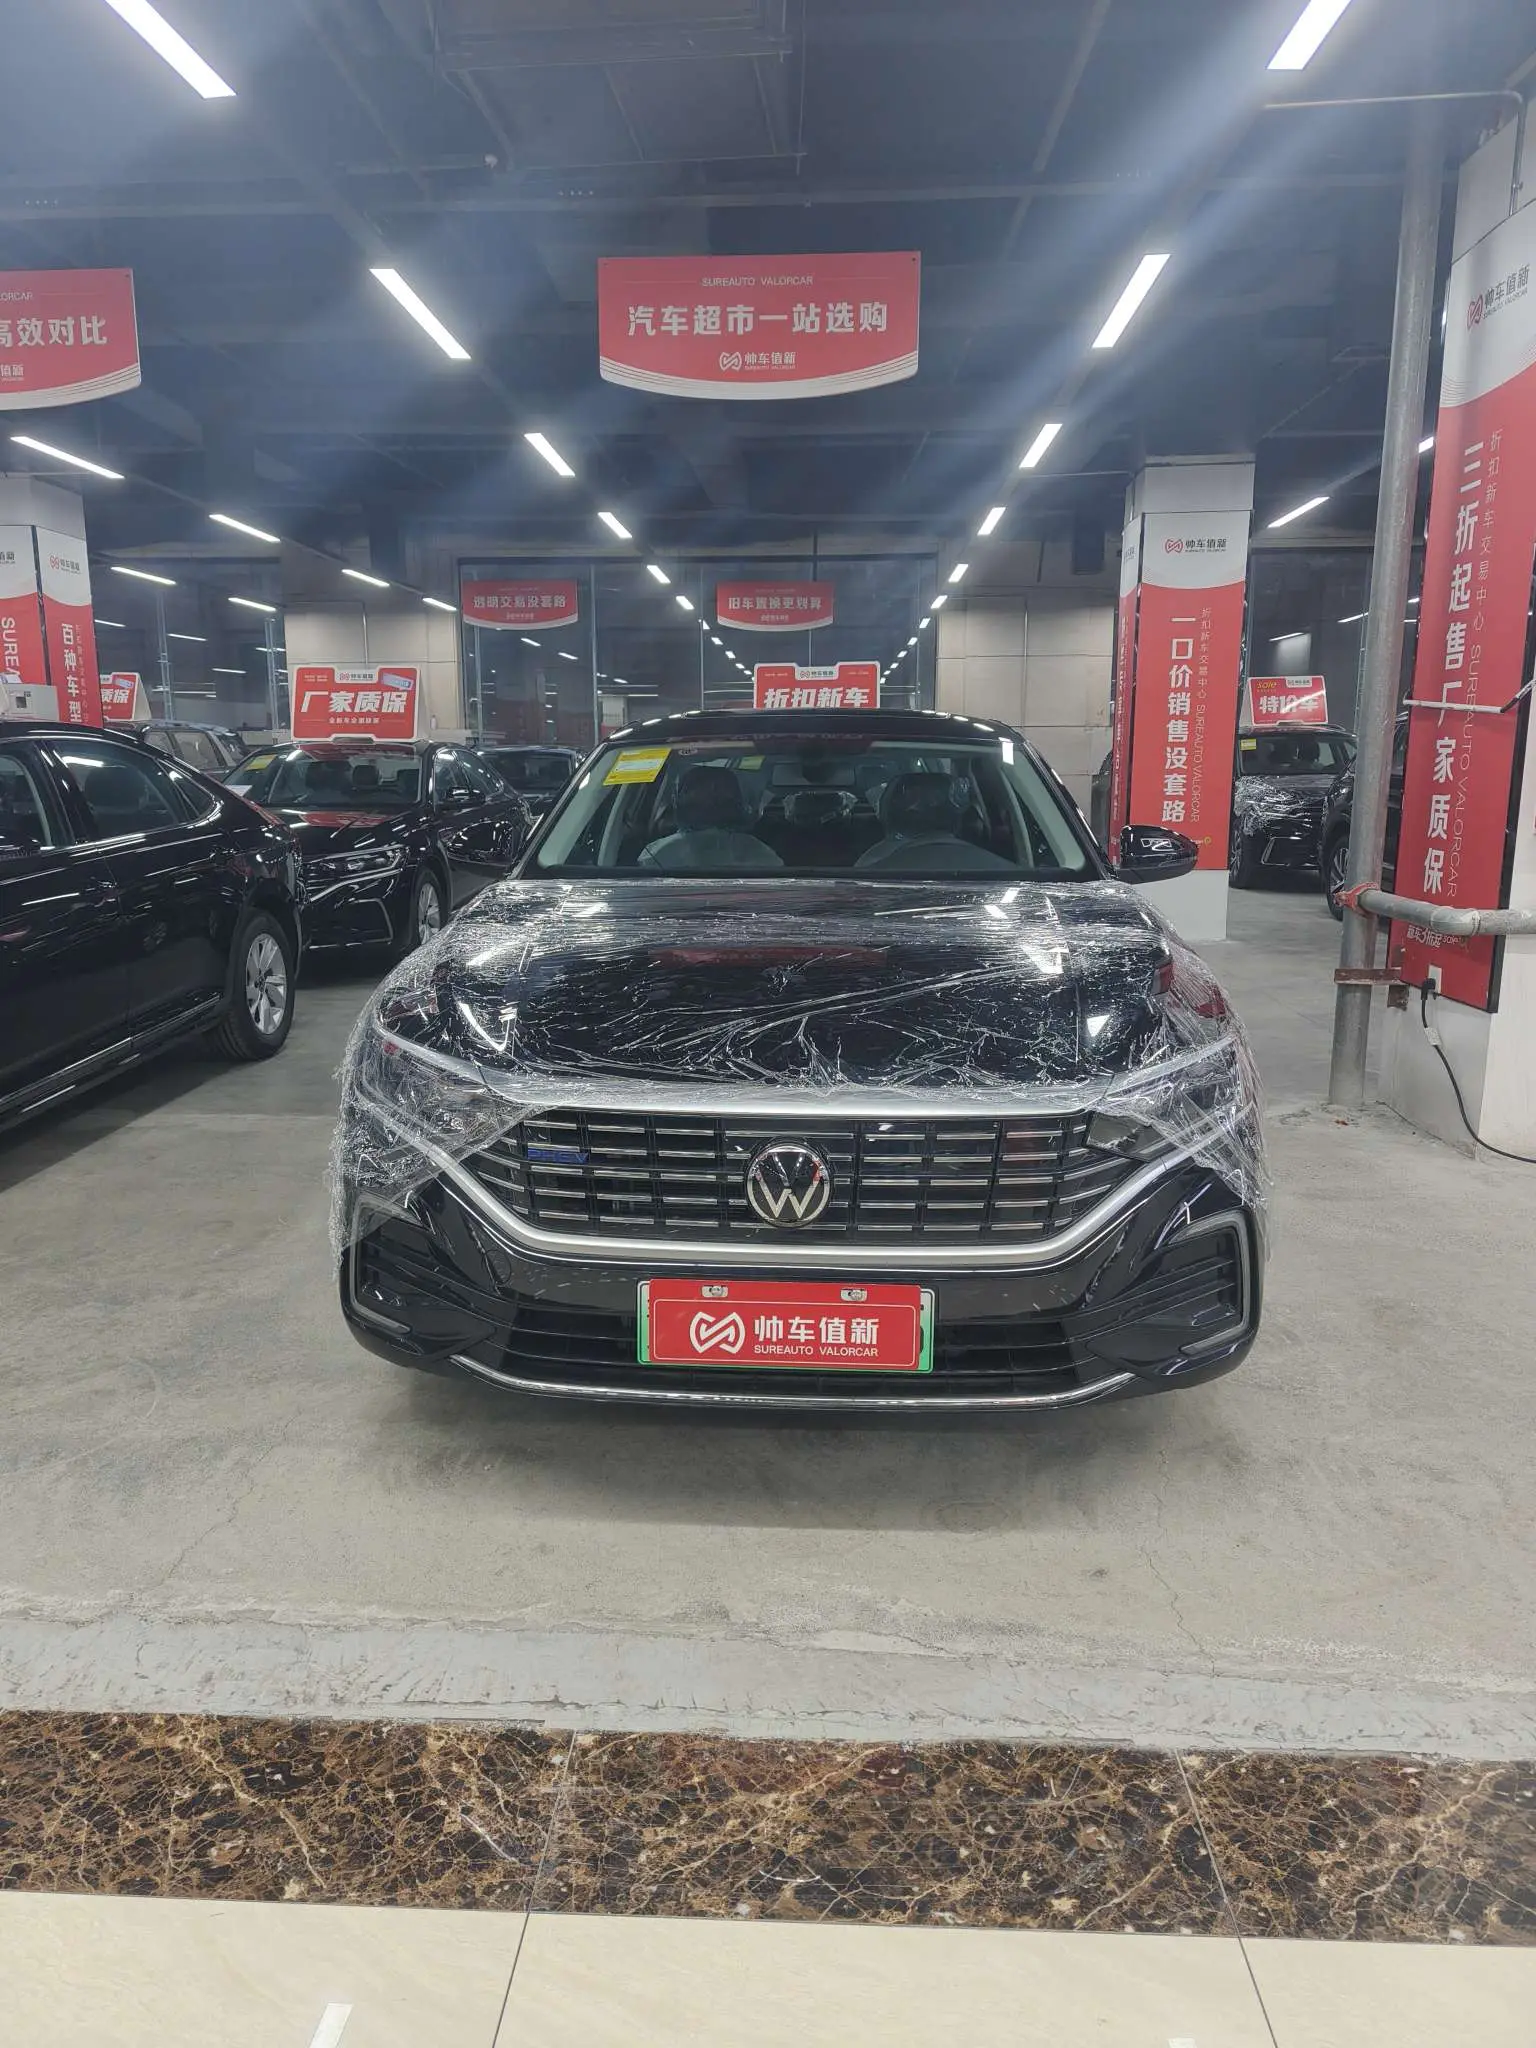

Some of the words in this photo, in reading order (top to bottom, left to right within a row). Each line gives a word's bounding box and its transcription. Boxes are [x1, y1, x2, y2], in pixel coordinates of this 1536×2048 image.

[702, 278, 755, 287] SUREAUTO
[760, 276, 813, 286] VALORCAR
[628, 302, 887, 336] 汽车超市一站选购
[744, 351, 796, 365] 帅车值新
[1472, 428, 1504, 632] 折扣新车交易中心
[62, 623, 82, 723] 百种车型
[1423, 441, 1484, 894] 三折起售厂家质保
[300, 690, 408, 713] 厂家质保
[764, 686, 870, 708] 折扣新车
[1460, 645, 1481, 771] SUREAUTO
[1161, 617, 1197, 823] 一口价销售没套路
[1447, 776, 1470, 898] VALORCAR
[754, 1315, 880, 1345] 帅车值新
[754, 1344, 815, 1356] SUREAUTO
[819, 1345, 879, 1358] VALORCAR
